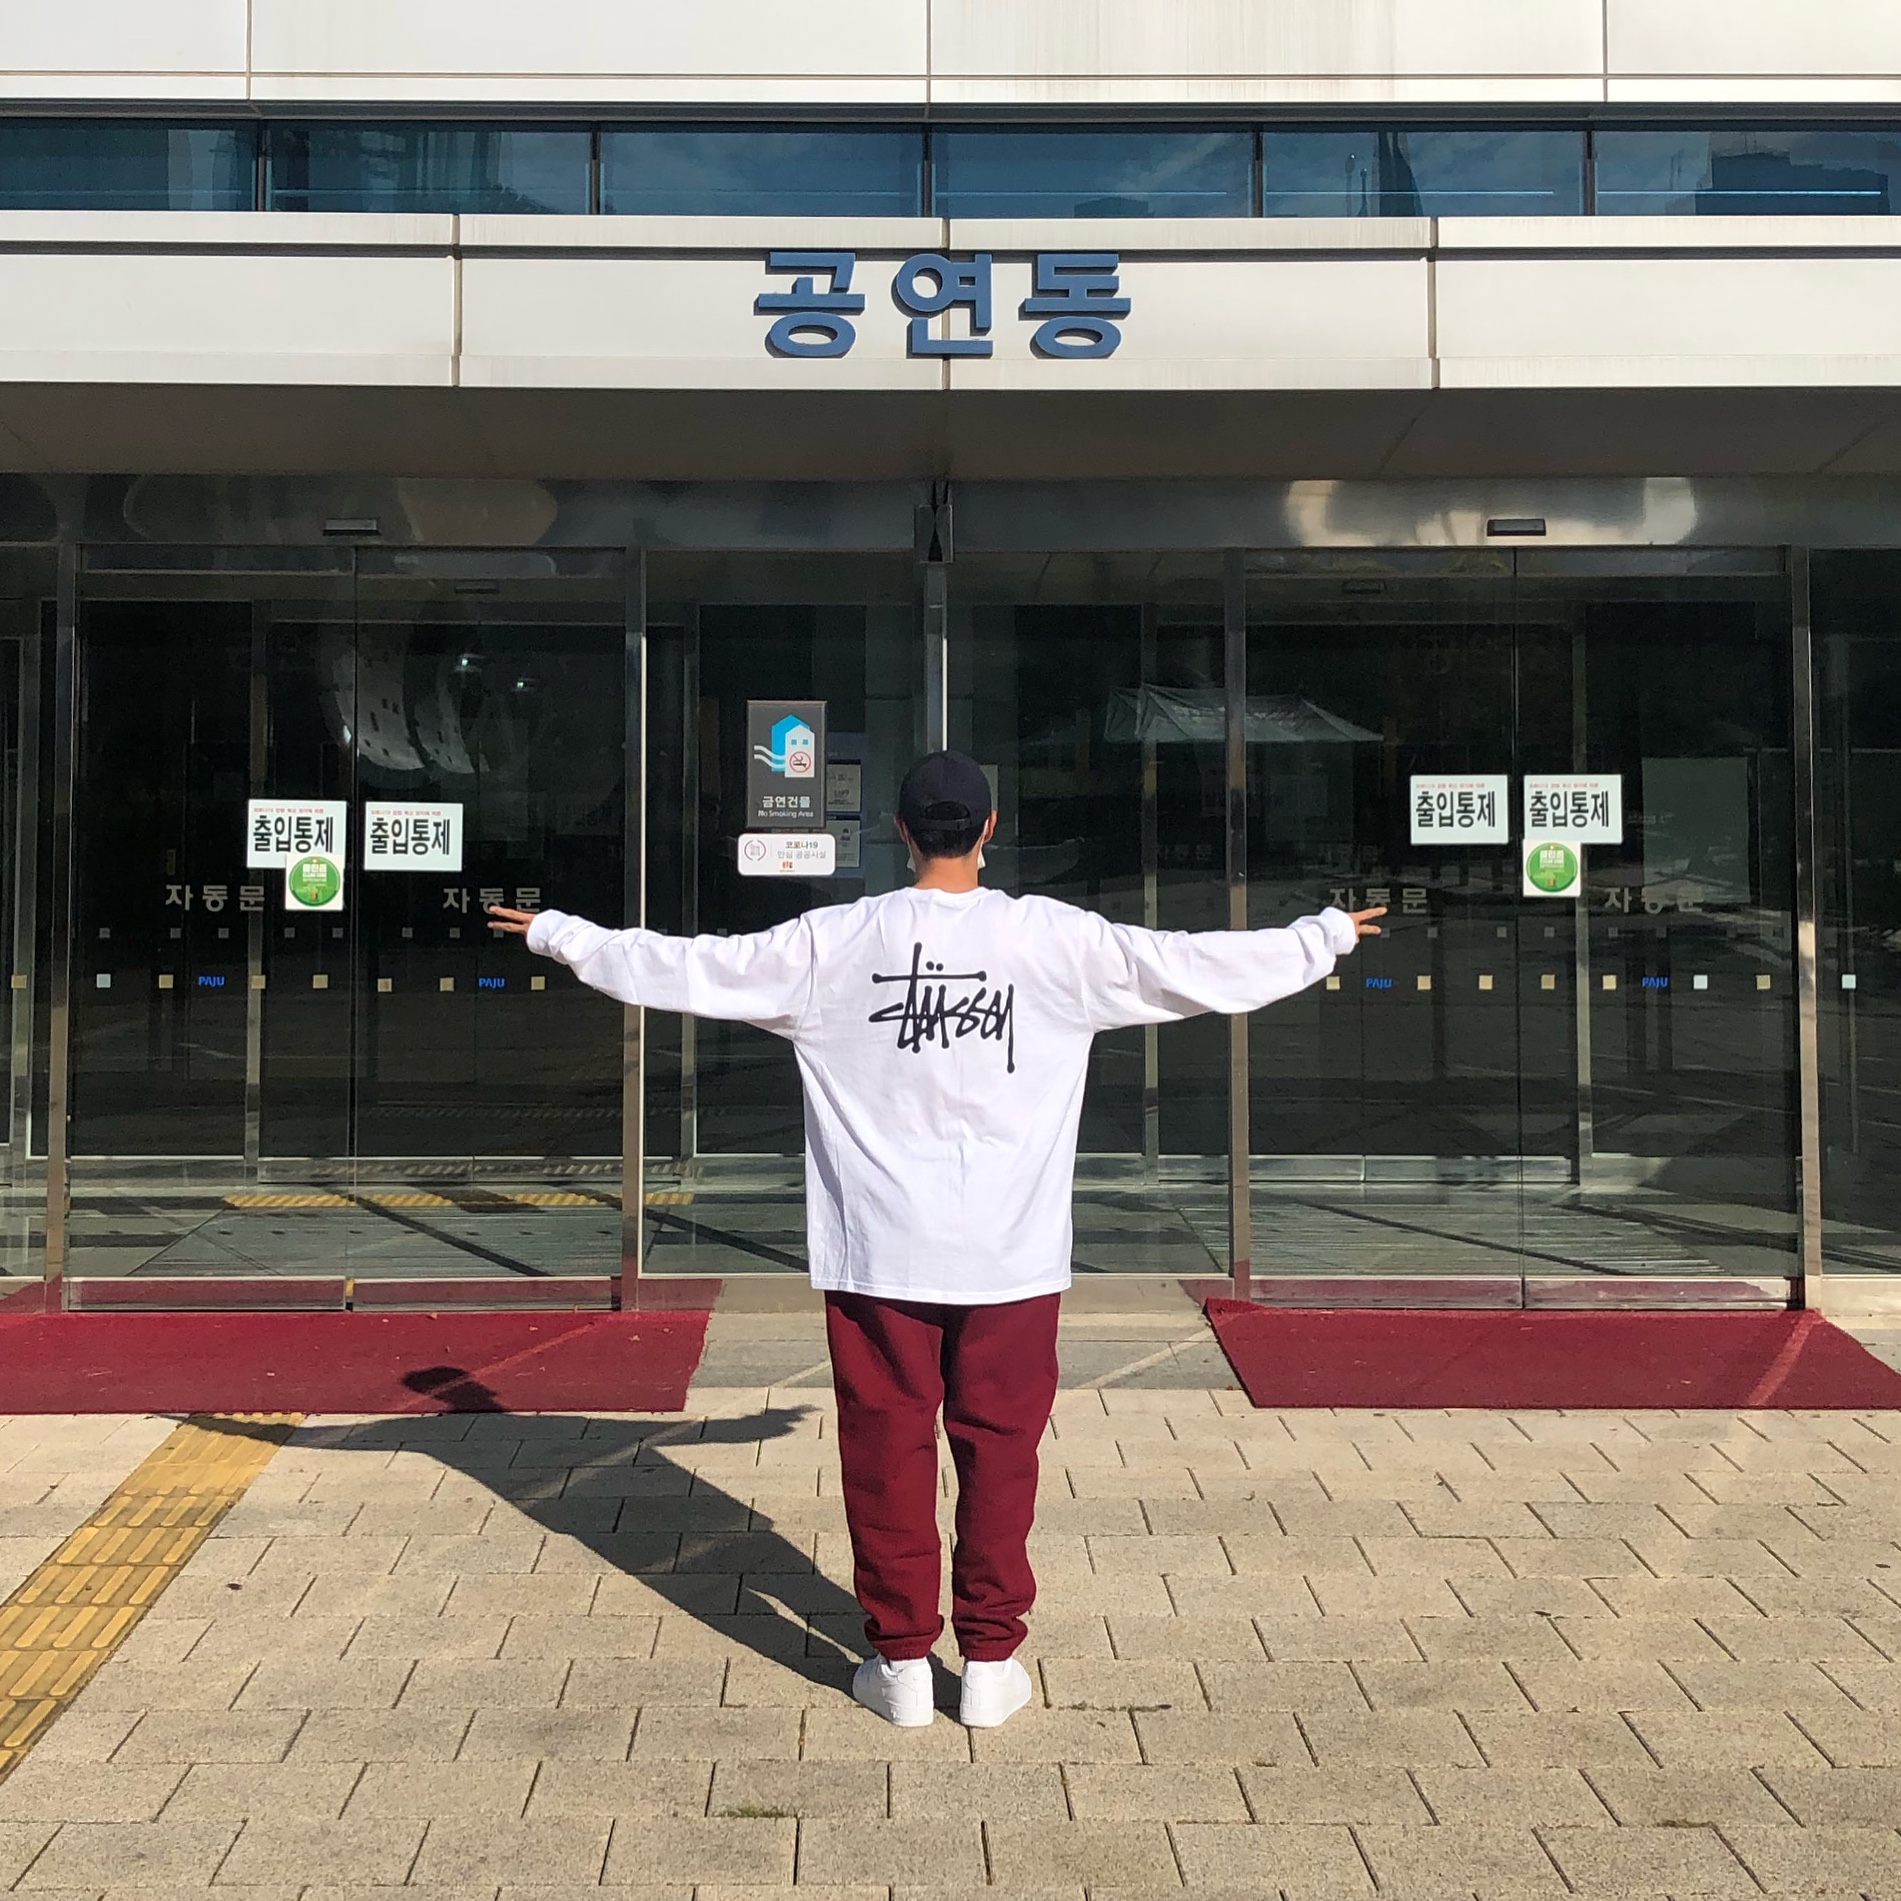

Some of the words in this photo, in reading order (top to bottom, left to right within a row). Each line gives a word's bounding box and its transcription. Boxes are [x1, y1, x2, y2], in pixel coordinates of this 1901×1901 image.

[756, 252, 1131, 359] 공연동
[762, 796, 811, 809] 금연건물
[1416, 791, 1495, 828] 출입통제
[1530, 791, 1609, 828] 출입통제
[757, 810, 768, 818] No
[769, 810, 797, 818] Smoking
[798, 810, 814, 818] Area
[253, 815, 334, 853] 출입통제
[370, 817, 450, 855] 출입통제
[786, 841, 818, 849] 코로나19
[165, 884, 265, 913] 자동문
[442, 887, 541, 915] 자동문
[197, 975, 226, 987] PAJU
[478, 976, 506, 989] PAJU
[1364, 977, 1393, 989] PAJU
[1641, 976, 1669, 988] PAJU
